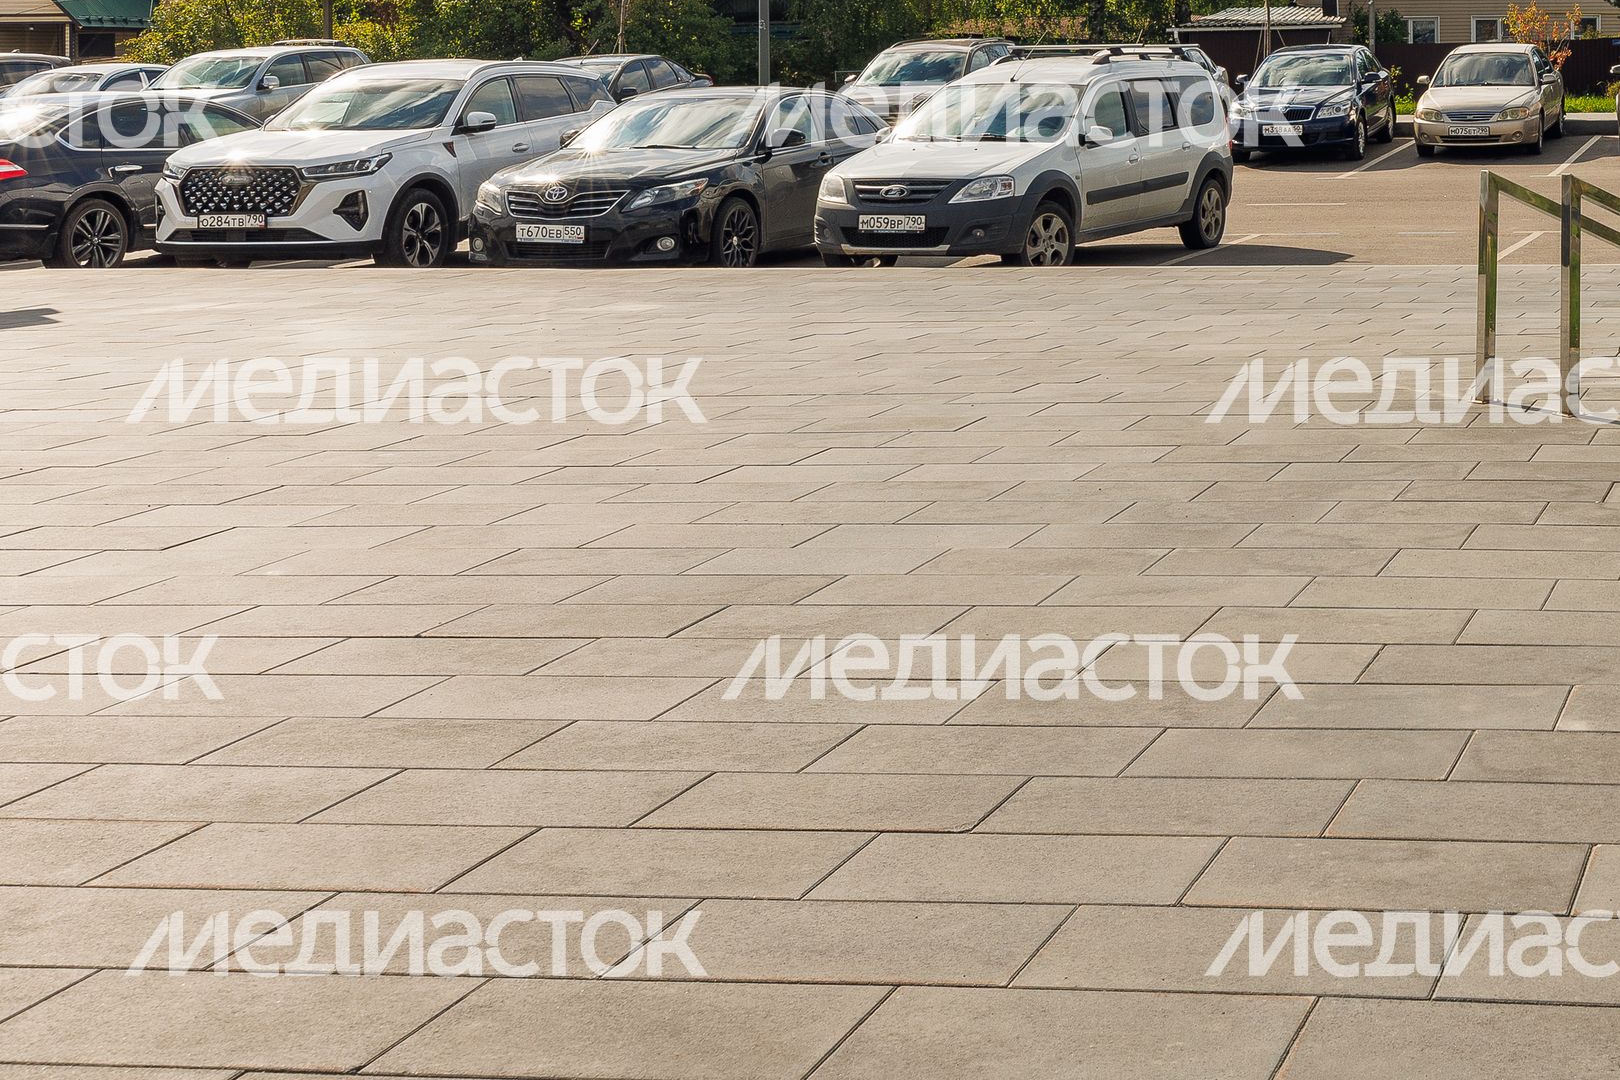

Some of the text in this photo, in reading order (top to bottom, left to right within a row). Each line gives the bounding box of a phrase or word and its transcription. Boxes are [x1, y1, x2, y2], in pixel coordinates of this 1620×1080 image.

[247, 214, 264, 224] 790
[905, 216, 923, 226] 790
[564, 226, 582, 236] 550
